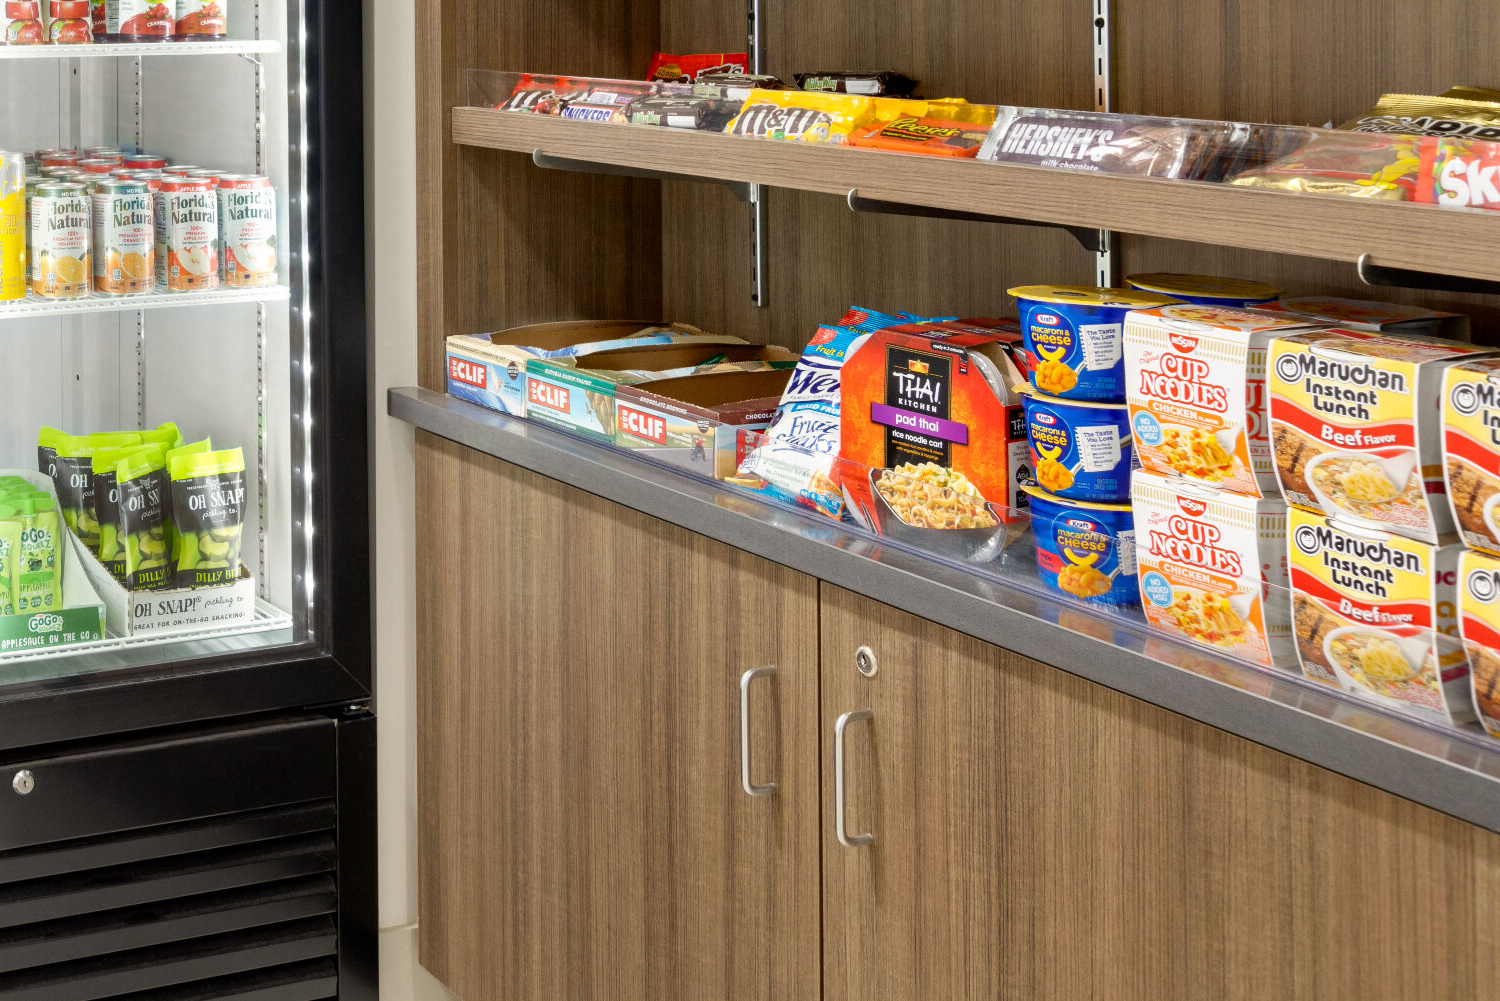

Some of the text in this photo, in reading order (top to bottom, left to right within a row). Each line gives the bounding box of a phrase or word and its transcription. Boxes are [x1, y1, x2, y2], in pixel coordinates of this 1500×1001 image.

[886, 116, 961, 138] Reese's
[1001, 122, 1114, 158] HERSHEY'S
[1040, 158, 1099, 172] milk chocolate
[170, 209, 216, 224] Natural
[227, 206, 273, 221] Natural
[1171, 336, 1198, 349] NISSIN
[457, 361, 485, 387] CLIF
[1159, 352, 1210, 382] CUP
[1298, 352, 1406, 392] Maruchan
[537, 383, 569, 410] CLIF
[892, 370, 941, 405] THAI
[1140, 370, 1228, 413] NOODLES
[1304, 378, 1378, 407] Instant
[898, 397, 938, 414] KITCHEN
[1152, 402, 1219, 424] CHICKEN FLAVOR
[1312, 396, 1370, 421] Lunch
[628, 412, 665, 440] CLIF
[789, 413, 840, 446] Fruit
[895, 413, 939, 433] pad thai
[1136, 425, 1158, 434] ADDED
[892, 430, 943, 449] rice noodle cart
[1320, 425, 1397, 447] Beef Flavor
[188, 486, 245, 511] OH SNAP!
[1056, 528, 1094, 542] macaroni
[1168, 513, 1221, 544] CUP
[1149, 530, 1243, 577] NOODLES
[1315, 523, 1422, 573] Maruchan
[195, 568, 222, 583] DILLY
[1322, 550, 1394, 584] Instant
[1331, 570, 1388, 599] Lunch
[1339, 597, 1414, 624] Beef Flavor
[1, 631, 90, 649] APPLESAUCE ON THE GO
